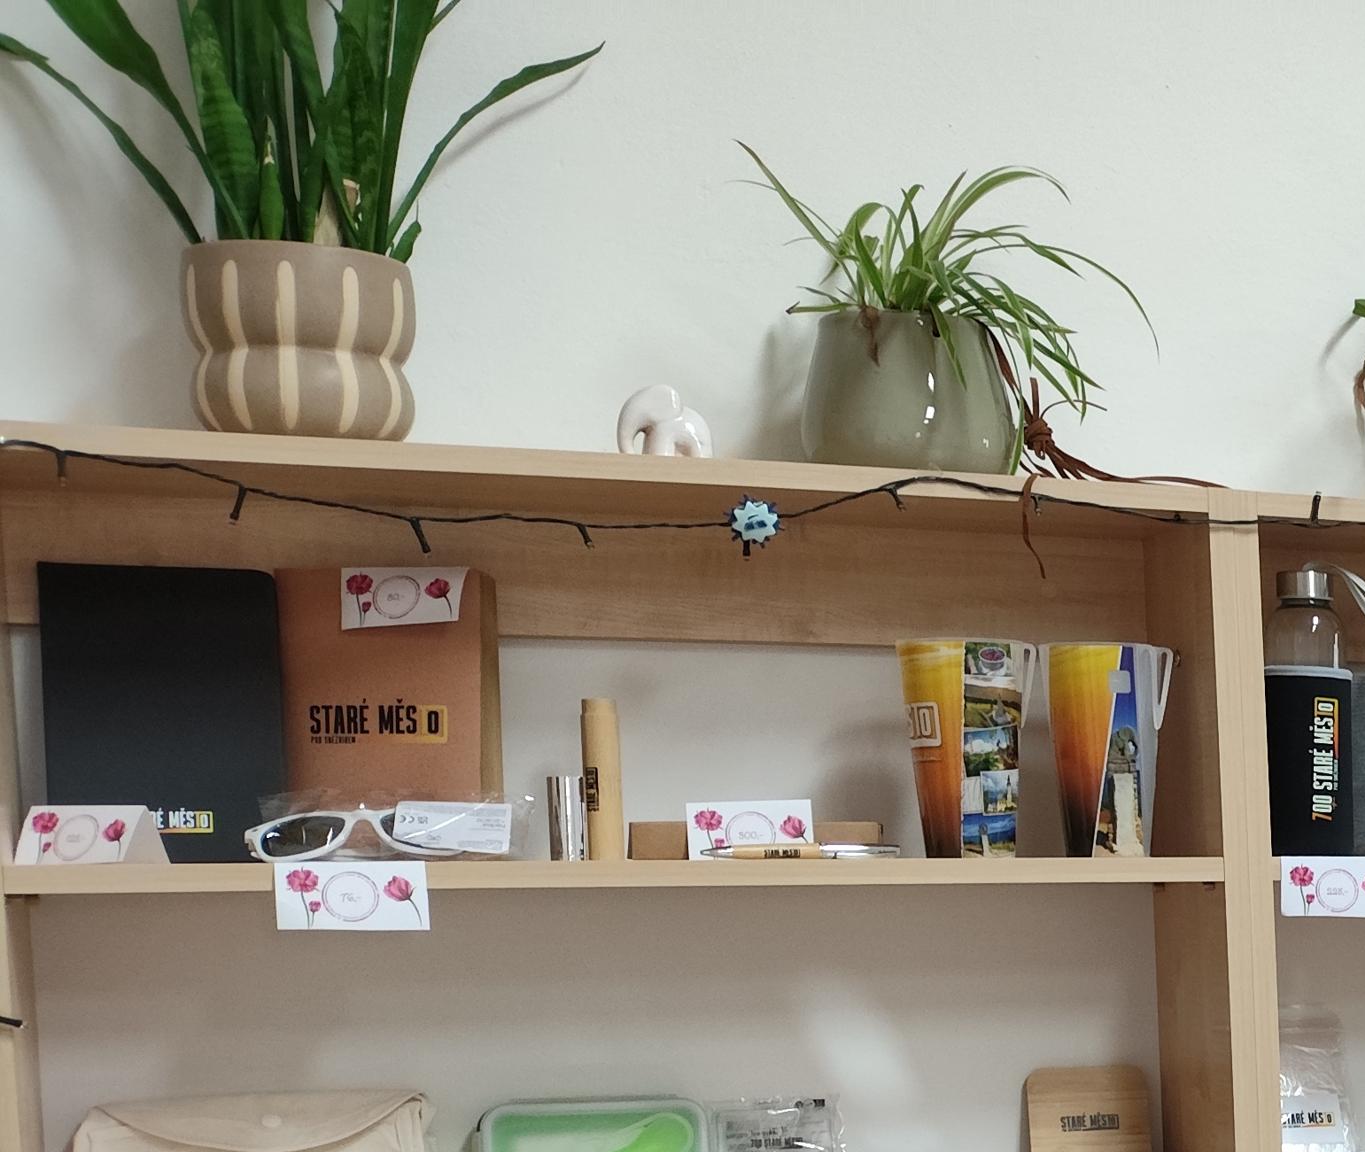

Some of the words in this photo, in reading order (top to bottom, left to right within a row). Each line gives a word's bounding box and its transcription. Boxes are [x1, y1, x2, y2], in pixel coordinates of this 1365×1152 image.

[309, 698, 370, 735] STARÉ
[1309, 701, 1335, 745] MĚSTO
[1309, 747, 1334, 791] STARÉ
[1312, 794, 1333, 821] 700
[1060, 1112, 1087, 1129] STARÉ
